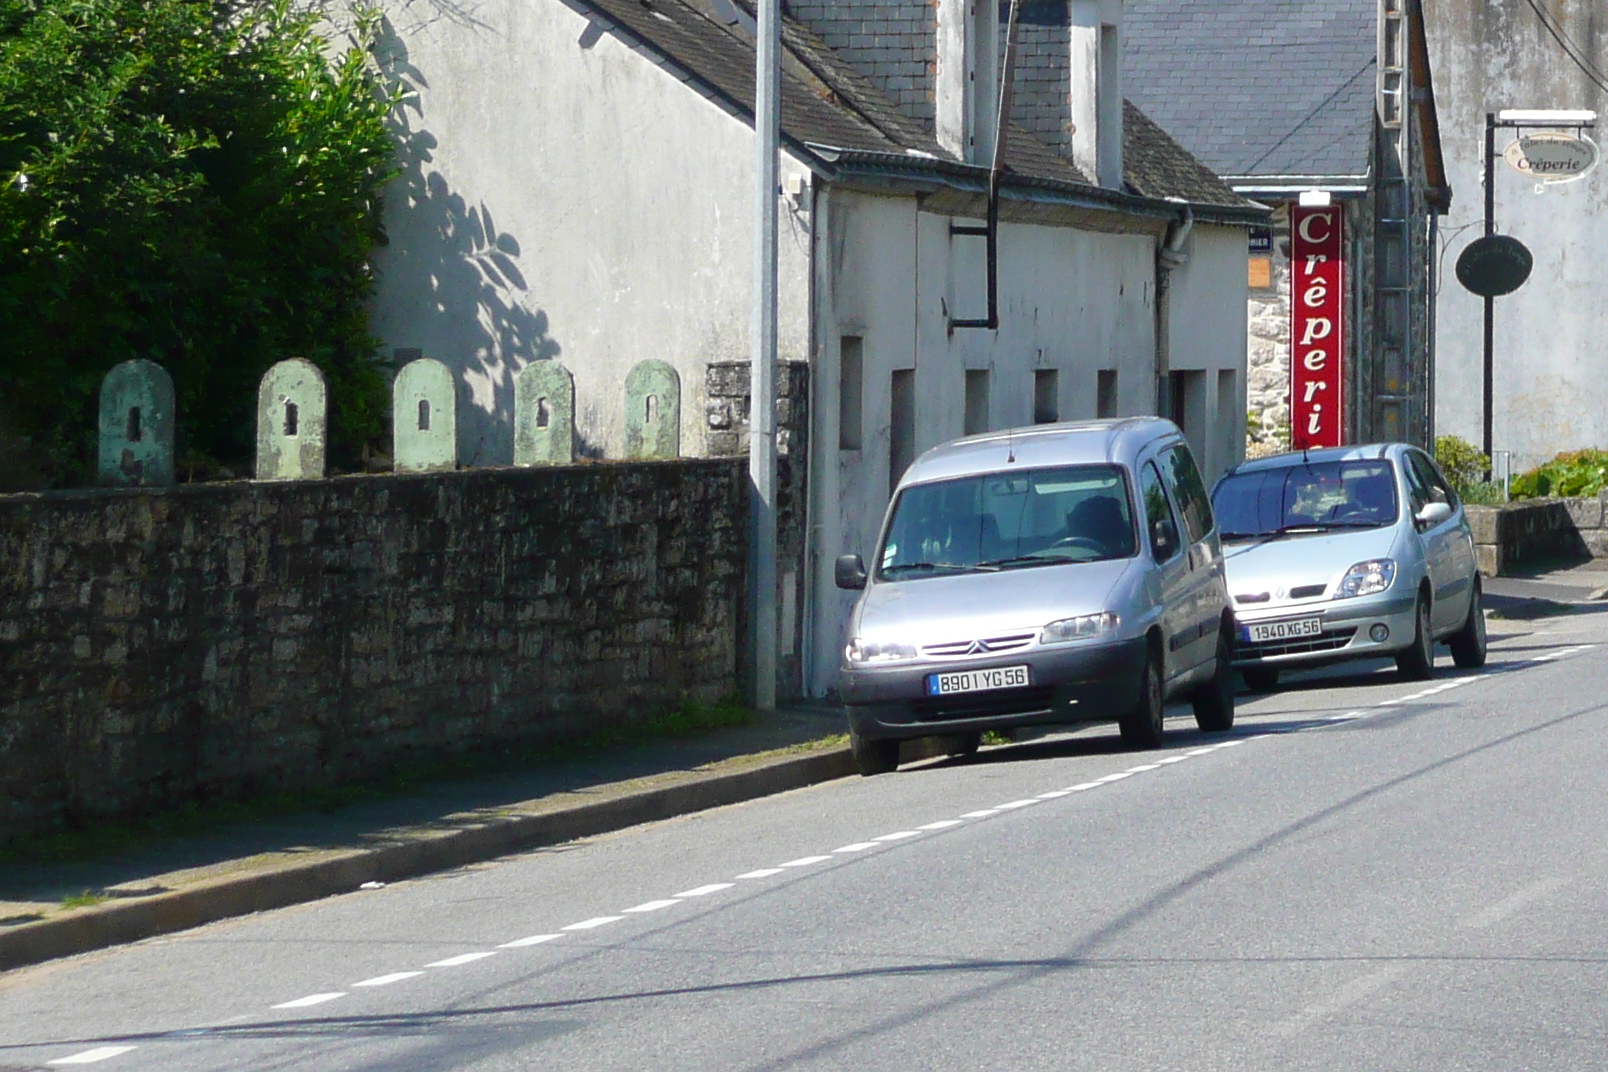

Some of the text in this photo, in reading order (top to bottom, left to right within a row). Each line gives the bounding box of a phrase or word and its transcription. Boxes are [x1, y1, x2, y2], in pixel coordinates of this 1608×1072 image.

[1517, 157, 1581, 172] Crêperie
[1298, 212, 1333, 450] Crêperi
[1255, 620, 1319, 639] 1940 XG 56
[940, 668, 1025, 692] 8901 YG 56
